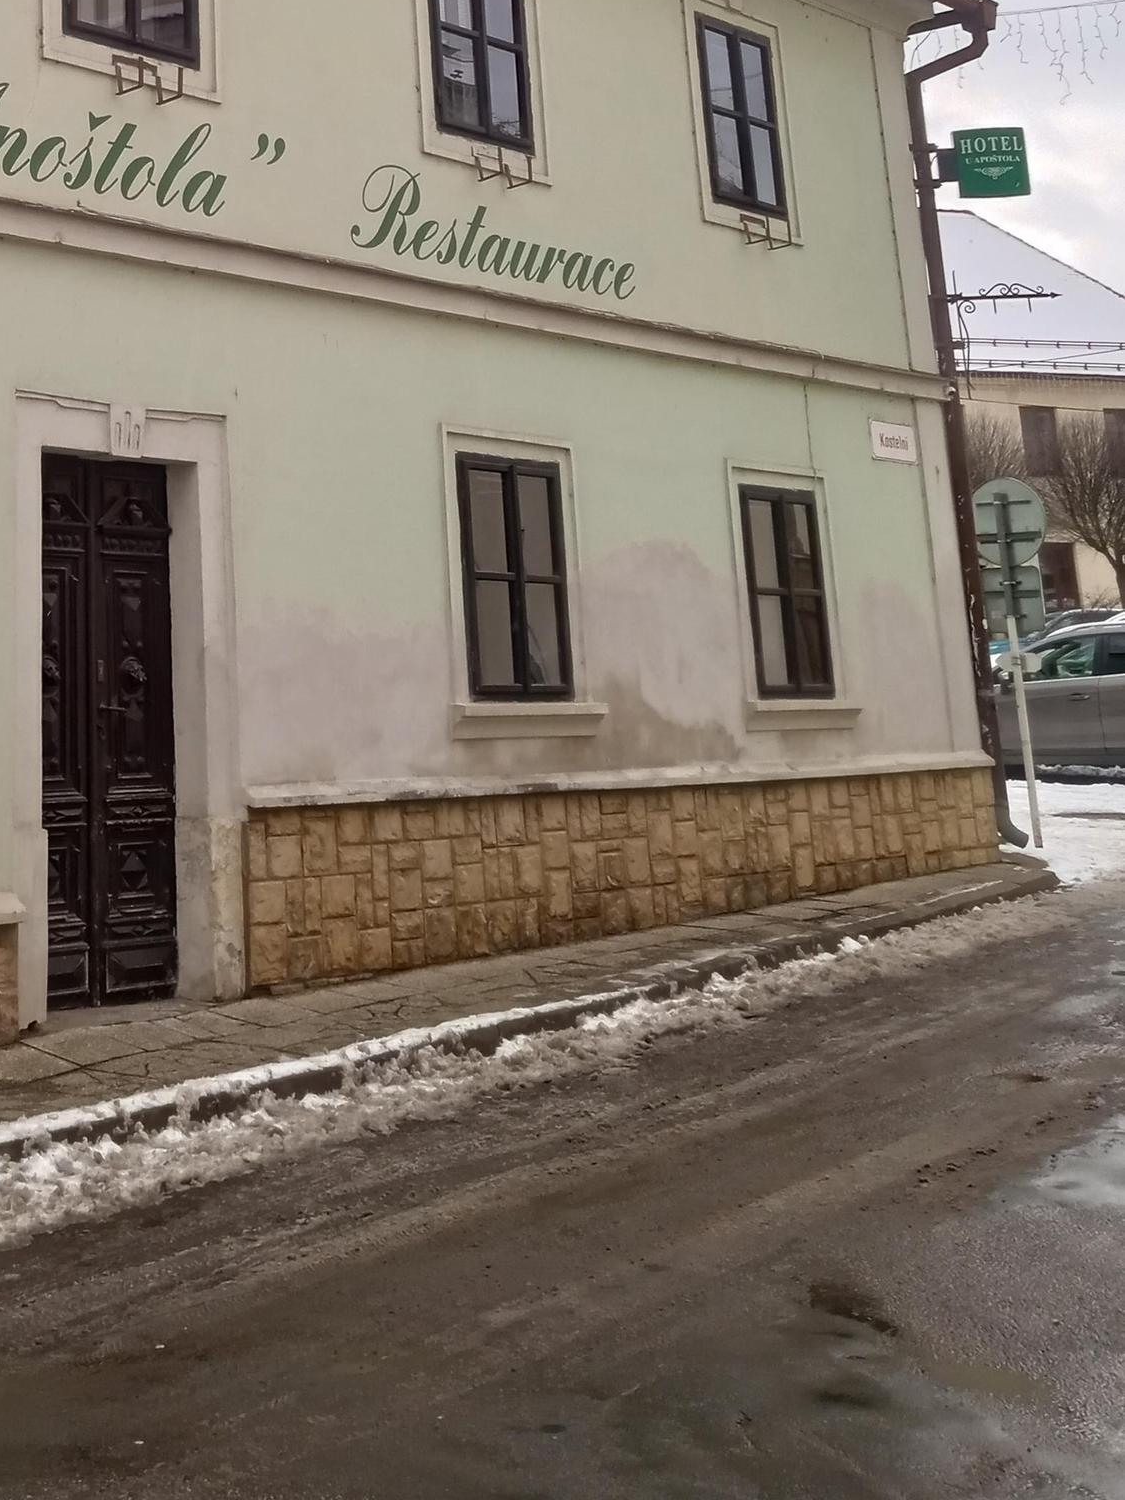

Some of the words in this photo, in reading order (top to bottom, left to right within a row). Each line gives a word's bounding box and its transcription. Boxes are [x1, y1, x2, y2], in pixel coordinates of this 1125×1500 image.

[960, 136, 1023, 154] HOTEL
[974, 154, 1021, 164] APOŠTOLA
[350, 164, 636, 300] Restaurace
